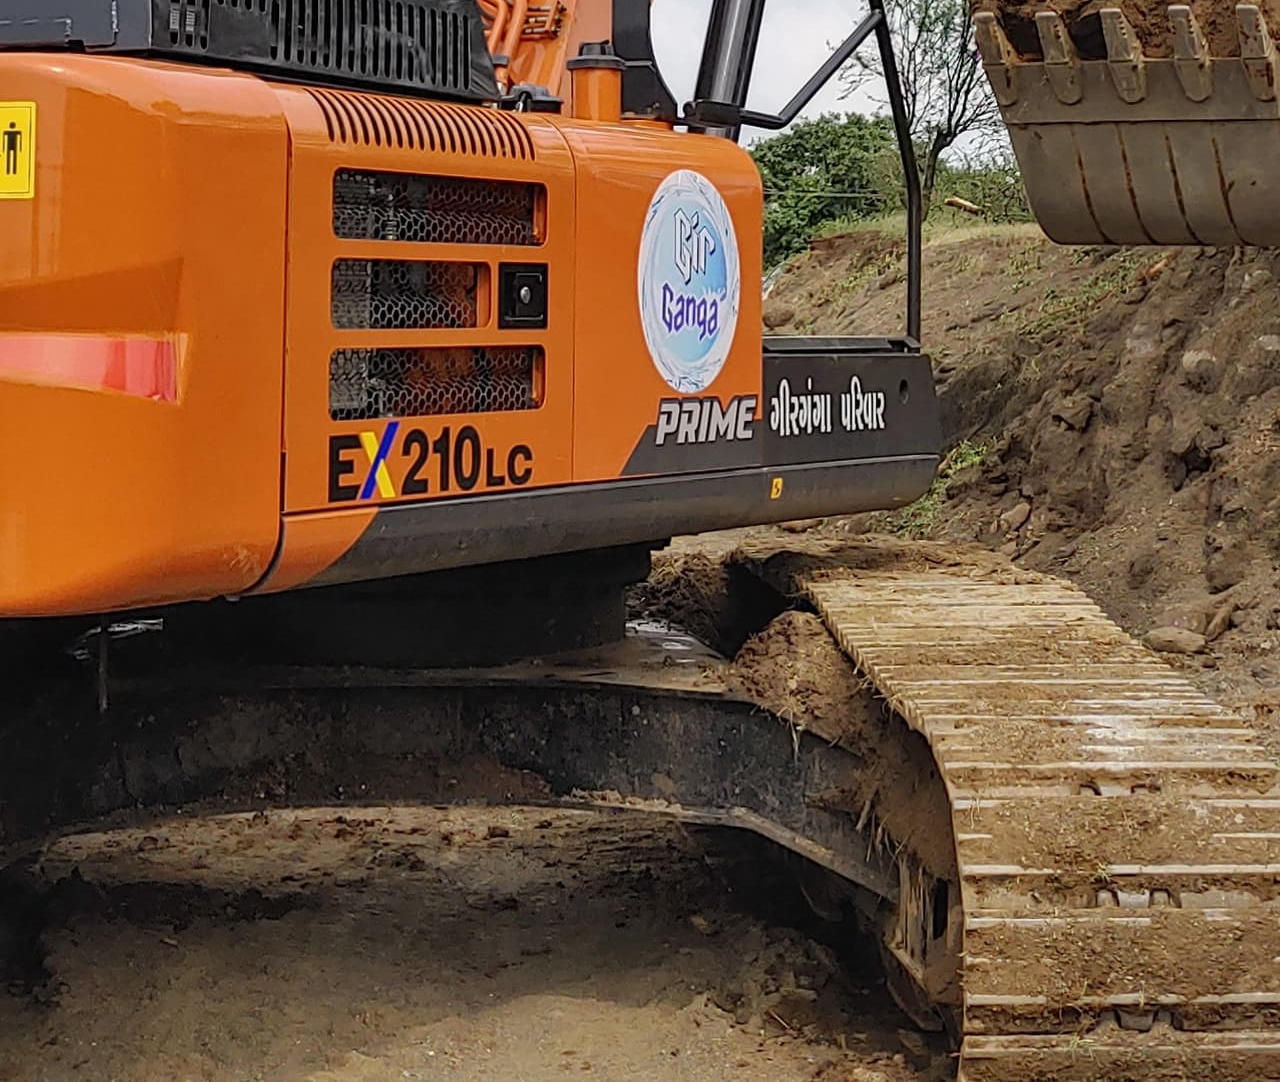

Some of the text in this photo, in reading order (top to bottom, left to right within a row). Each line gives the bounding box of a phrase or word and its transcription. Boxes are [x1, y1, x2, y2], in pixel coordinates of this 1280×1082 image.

[673, 206, 716, 286] Gir
[661, 283, 719, 342] Ganga
[655, 396, 758, 446] PRIME
[770, 375, 885, 437] ગીરગંગા પરિવાર
